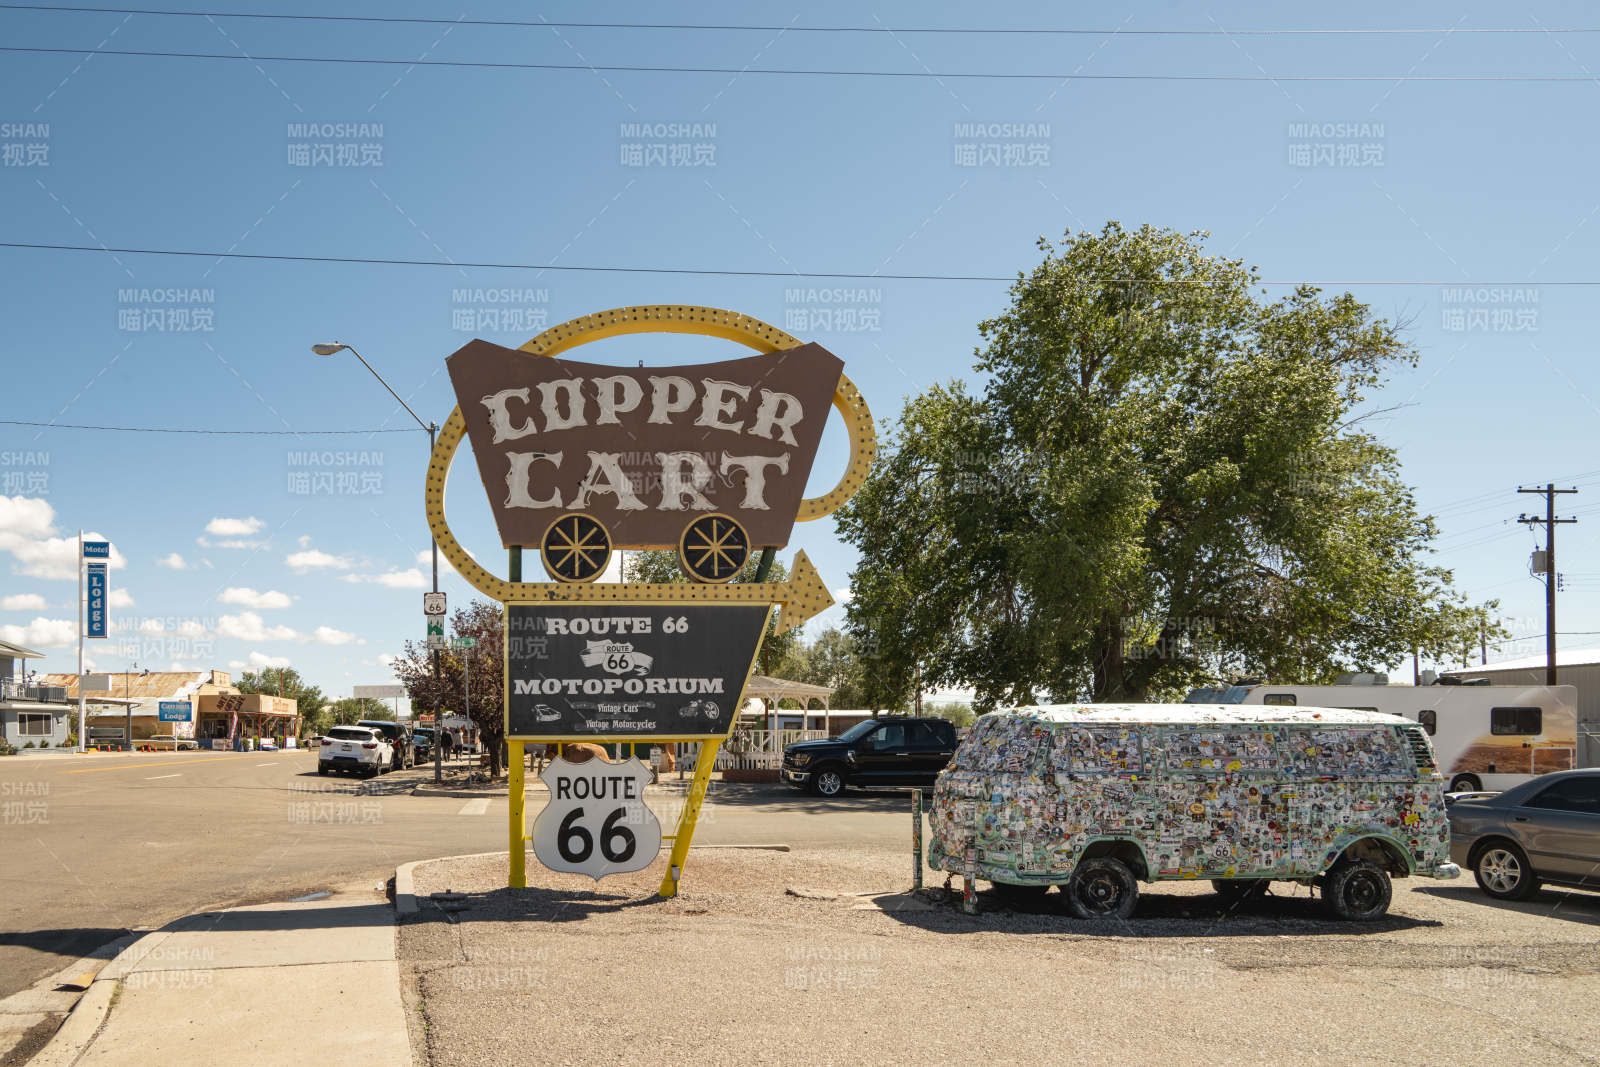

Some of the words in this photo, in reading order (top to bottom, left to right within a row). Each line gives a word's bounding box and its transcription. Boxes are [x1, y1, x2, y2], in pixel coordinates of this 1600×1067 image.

[480, 375, 805, 447] COPPER
[504, 450, 790, 511] CART
[92, 576, 102, 630] Lodge
[430, 602, 442, 612] 66
[546, 617, 652, 635] ROUTE
[662, 616, 689, 634] 66
[607, 654, 629, 670] 66
[514, 678, 725, 695] MOTOPORIUM
[598, 704, 622, 714] Vintage
[623, 704, 639, 712] Cars
[586, 720, 609, 730] Vintage
[612, 720, 656, 730] Motorcycles
[556, 776, 636, 800] ROUTE
[557, 806, 636, 864] 66
[1216, 848, 1228, 856] 66
